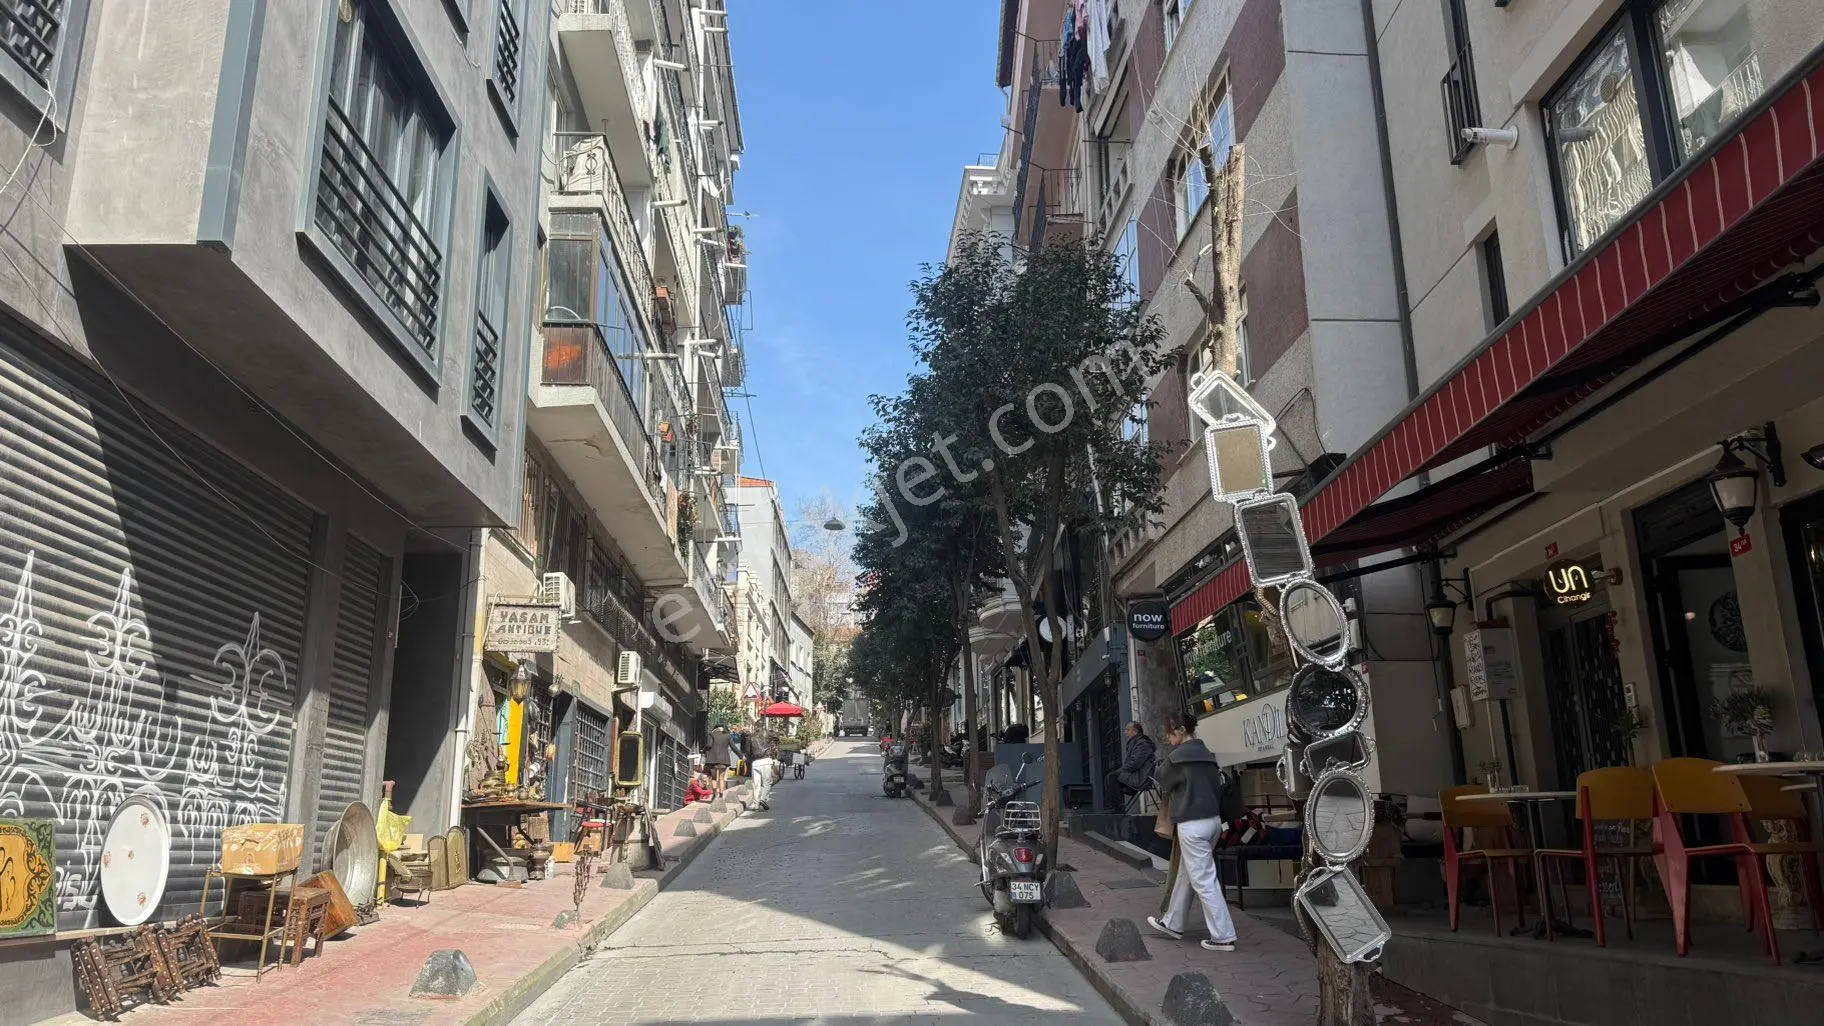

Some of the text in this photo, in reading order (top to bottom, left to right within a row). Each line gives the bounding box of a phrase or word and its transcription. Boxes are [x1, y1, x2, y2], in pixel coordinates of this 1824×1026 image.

[1557, 592, 1591, 604] Cihangir
[1133, 613, 1163, 622] now
[495, 624, 552, 635] ANTIQUE
[1132, 622, 1165, 630] furniture
[1012, 883, 1039, 892] 34 NCY
[1018, 891, 1034, 900] 075
